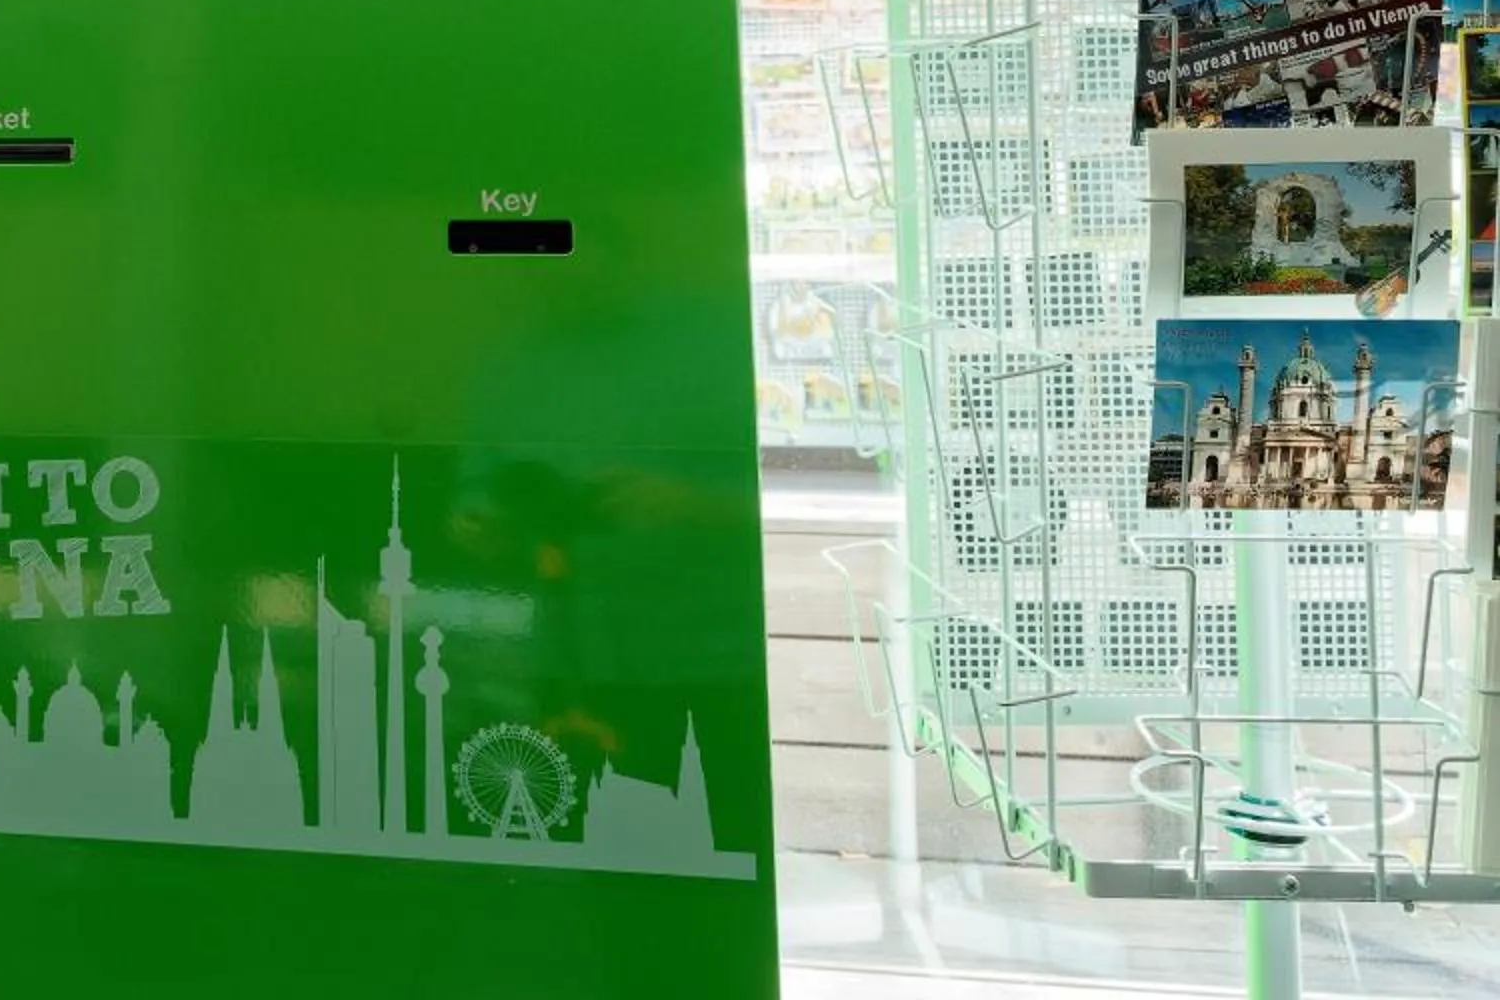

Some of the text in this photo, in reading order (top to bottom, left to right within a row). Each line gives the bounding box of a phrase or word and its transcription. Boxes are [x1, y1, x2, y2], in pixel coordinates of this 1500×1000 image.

[1193, 49, 1238, 77] great
[1242, 38, 1298, 62] things
[1301, 30, 1320, 47] to
[1324, 22, 1345, 40] do
[1348, 17, 1367, 34] in
[481, 190, 538, 216] Key
[28, 455, 161, 526] TO
